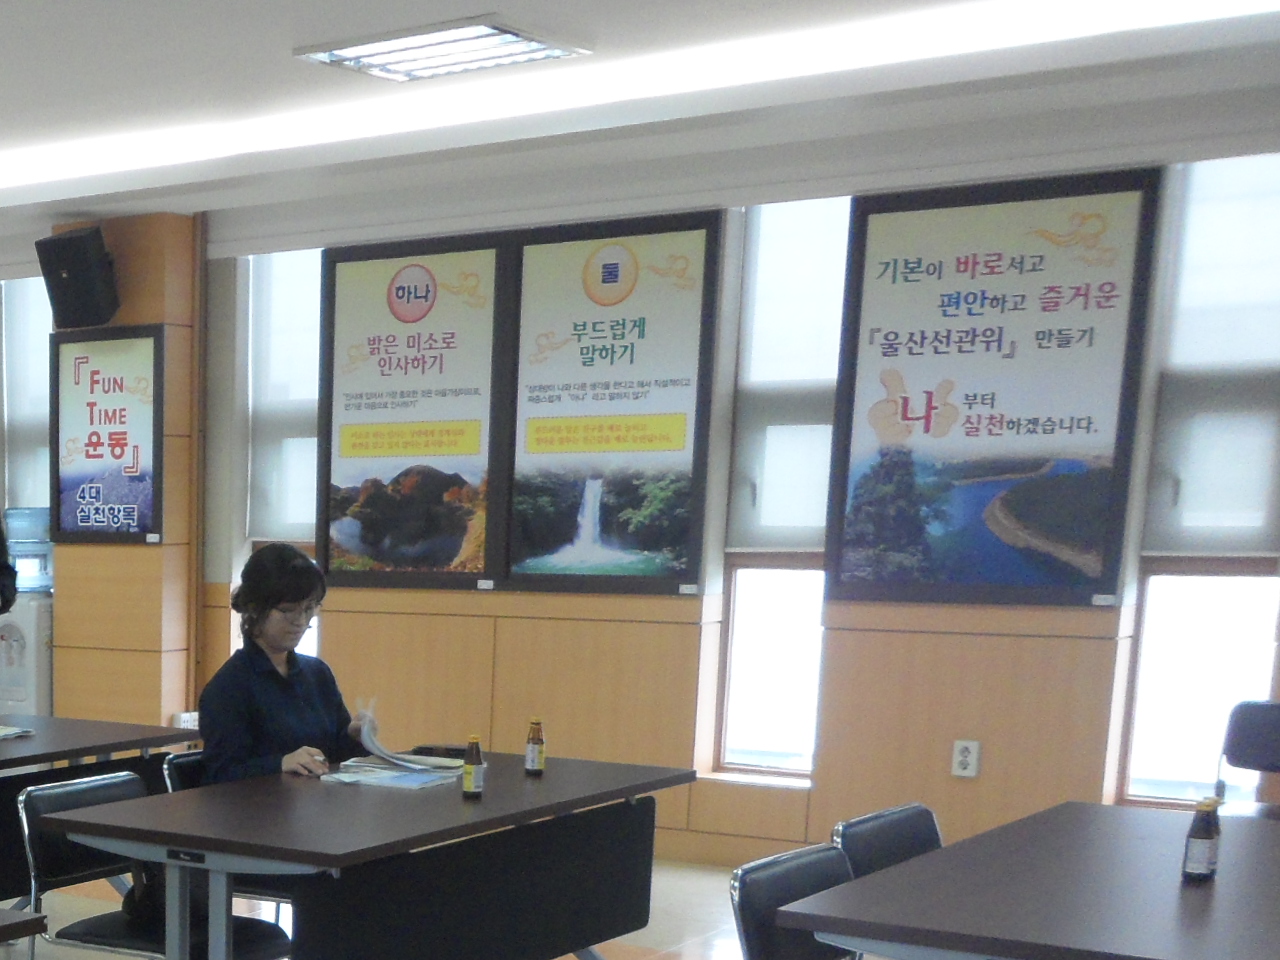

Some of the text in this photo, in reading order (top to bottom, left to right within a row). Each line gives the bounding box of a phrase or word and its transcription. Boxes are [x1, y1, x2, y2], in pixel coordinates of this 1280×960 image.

[601, 262, 620, 284] 둘
[876, 252, 1045, 284] 기본이 바로서고
[395, 284, 431, 304] 하나
[937, 281, 1120, 318] 편안하고 즐거운
[571, 317, 646, 342] 부드럽게
[1035, 326, 1095, 350] 만들기
[367, 332, 458, 355] 밝은 미소로
[579, 343, 636, 367] 말하기
[378, 353, 445, 377] 인사하기
[86, 402, 126, 426] TIME
[899, 390, 996, 434] 나 부터
[961, 413, 1099, 437] 실천하겠습니다.
[77, 484, 102, 503] 4대
[77, 505, 137, 526] 실천항목
